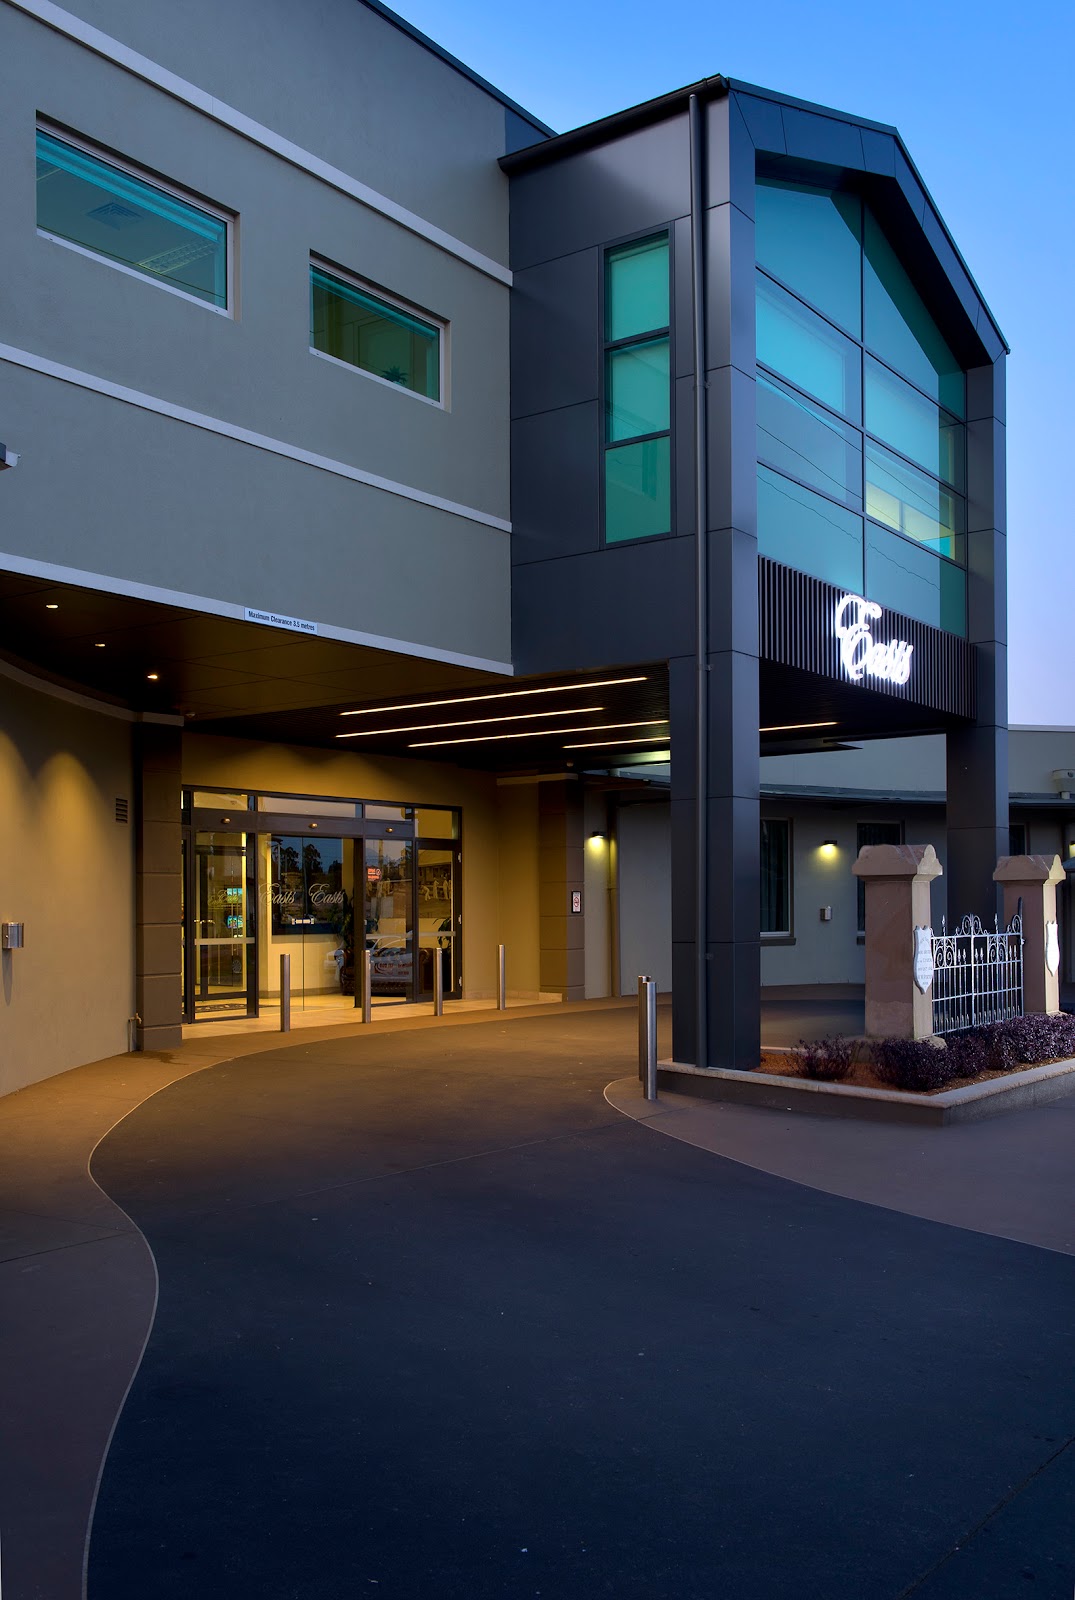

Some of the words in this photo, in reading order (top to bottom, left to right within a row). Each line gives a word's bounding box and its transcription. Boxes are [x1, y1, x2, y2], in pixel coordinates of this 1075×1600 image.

[248, 610, 270, 621] Maximum
[270, 615, 293, 627] Clearance
[292, 620, 300, 628] 3.5
[300, 623, 315, 631] metres
[258, 883, 296, 907] Easts
[308, 883, 345, 907] Easts
